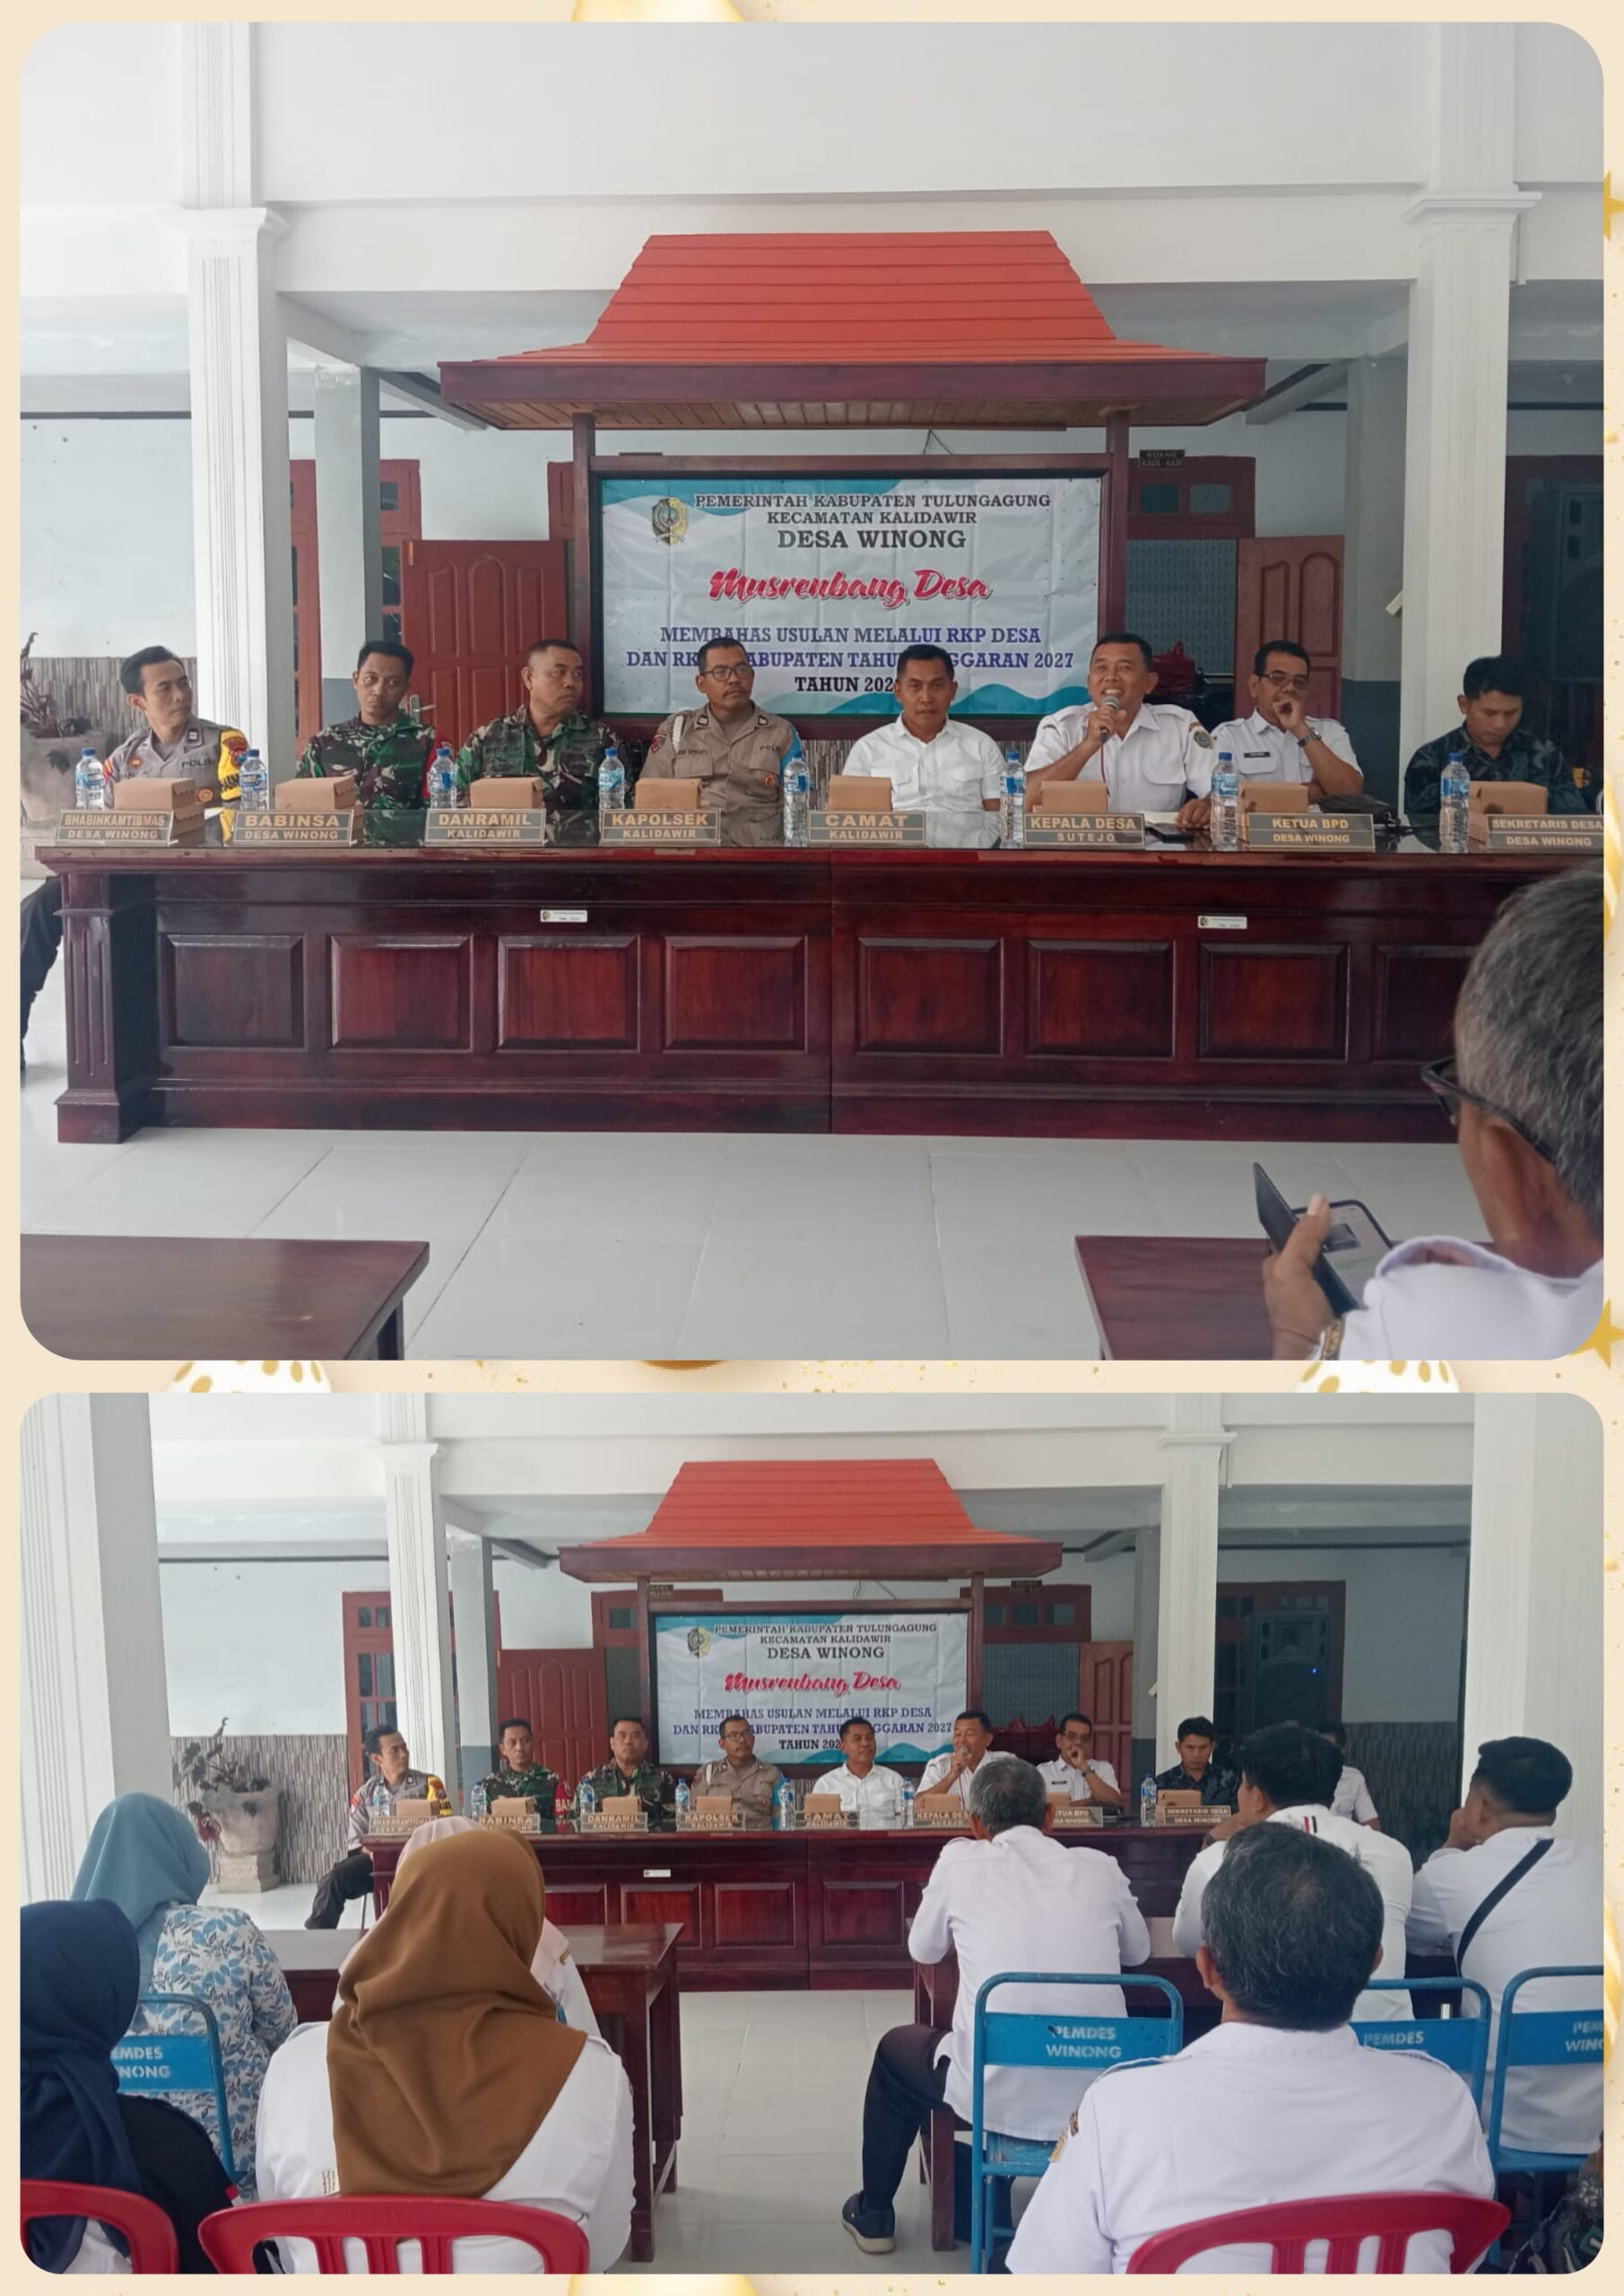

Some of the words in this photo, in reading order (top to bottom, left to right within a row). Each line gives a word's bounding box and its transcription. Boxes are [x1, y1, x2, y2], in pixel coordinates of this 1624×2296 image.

[695, 495, 807, 508] PEMERINTAH
[813, 495, 916, 508] KABUPATEN
[921, 495, 1051, 507] TULUNGAGUNG
[767, 512, 873, 524] KECAMATAN
[879, 512, 977, 524] KALIDAWIR
[777, 530, 848, 548] DESA
[856, 530, 967, 548] WINONG
[708, 567, 908, 609] Musrenbang
[913, 569, 992, 599] Desa
[660, 627, 771, 642] MEMBAHAS
[777, 627, 848, 642] USULAN
[854, 628, 942, 642] MELALUI
[946, 628, 986, 642] RKP
[991, 628, 1041, 643] DESA
[627, 651, 667, 667] DAN
[673, 652, 699, 666] RK
[748, 652, 843, 667] ABUPATEN
[847, 652, 899, 667] TAHU
[951, 652, 1029, 668] GGARAN
[1034, 653, 1073, 668] 2027
[795, 676, 859, 691] TAHUN
[864, 676, 893, 692] 202
[65, 813, 165, 827] BHABINKAMTIBMAS
[245, 814, 340, 827] BABINSA
[439, 813, 532, 826] DANRAMIL
[612, 813, 708, 826] KAPOLSEK
[825, 814, 908, 827] CAMAT
[1030, 817, 1090, 830] KEPALA
[1095, 817, 1136, 830] DESA
[1272, 818, 1317, 829] KETUA
[1322, 818, 1349, 829] BPD
[1491, 819, 1568, 830] SEKRETARIS
[1570, 820, 1603, 831] DESA
[67, 830, 100, 839] DESA
[105, 831, 158, 839] WINONG
[245, 831, 279, 839] DESA
[283, 831, 338, 840] WINONG
[447, 829, 521, 839] KALIDAWIR
[622, 829, 697, 839] KALIDAWIR
[829, 830, 904, 840] KALIDAWIR
[1056, 832, 1116, 843] SUTEJO
[1272, 833, 1300, 843] DESA
[1304, 833, 1350, 844] WINONG
[1507, 836, 1539, 846] DESA
[1541, 836, 1593, 847] WINONG
[715, 1624, 786, 1634] PEMERINTAH
[856, 1623, 937, 1632] TULUNGAGUNG
[760, 1635, 827, 1644] KECAMATAN
[830, 1635, 891, 1644] KALIDAWIR
[767, 1647, 812, 1659] DESA
[817, 1647, 885, 1658] WINONG
[852, 1671, 901, 1691] Desa
[767, 1709, 812, 1718] USULAN
[815, 1708, 870, 1718] MELALUI
[873, 1708, 898, 1718] RKP
[901, 1708, 932, 1718] DESA
[673, 1725, 699, 1735] DAN
[702, 1725, 718, 1735] RK
[750, 1724, 810, 1735] ABUPATEN
[812, 1724, 841, 1734] TAHU
[873, 1723, 925, 1734] GGARAN
[927, 1723, 952, 1733] 2027
[778, 1739, 820, 1750] TAHUN
[822, 1739, 840, 1749] 202
[952, 1812, 969, 1820] DES
[1053, 2026, 1116, 2040] PEMDES
[1573, 2022, 1603, 2034] PEM
[1363, 2031, 1424, 2046] PEMDES
[110, 2047, 163, 2060] EMDES
[1046, 2044, 1122, 2058] WINONG
[114, 2066, 171, 2078] NONG
